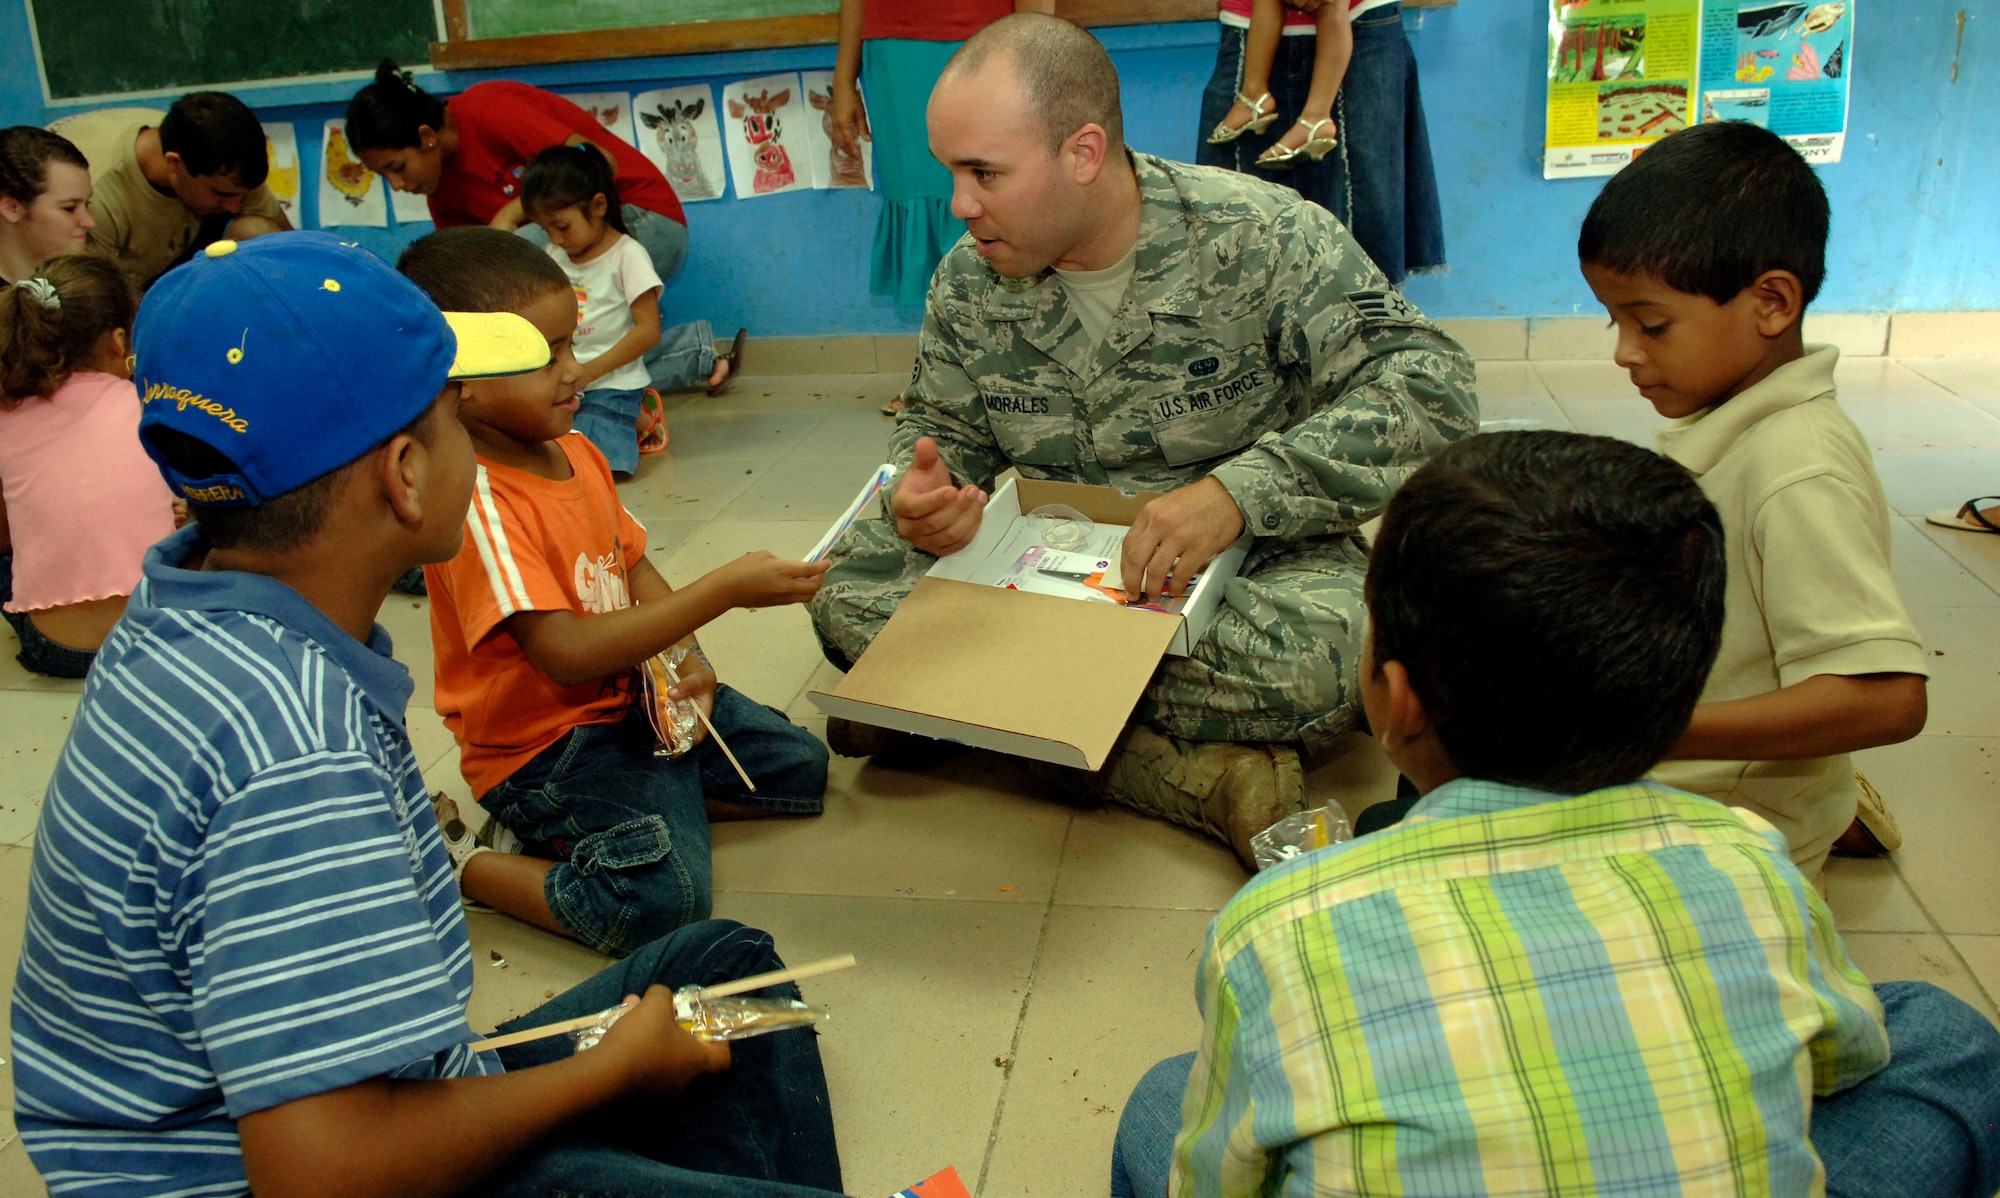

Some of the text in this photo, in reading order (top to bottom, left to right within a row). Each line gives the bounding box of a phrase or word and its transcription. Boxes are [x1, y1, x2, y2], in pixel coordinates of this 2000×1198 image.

[1797, 148, 1831, 157] ONY
[985, 394, 1049, 414] MORALES
[1159, 371, 1263, 418] U.S. AIR FORCE
